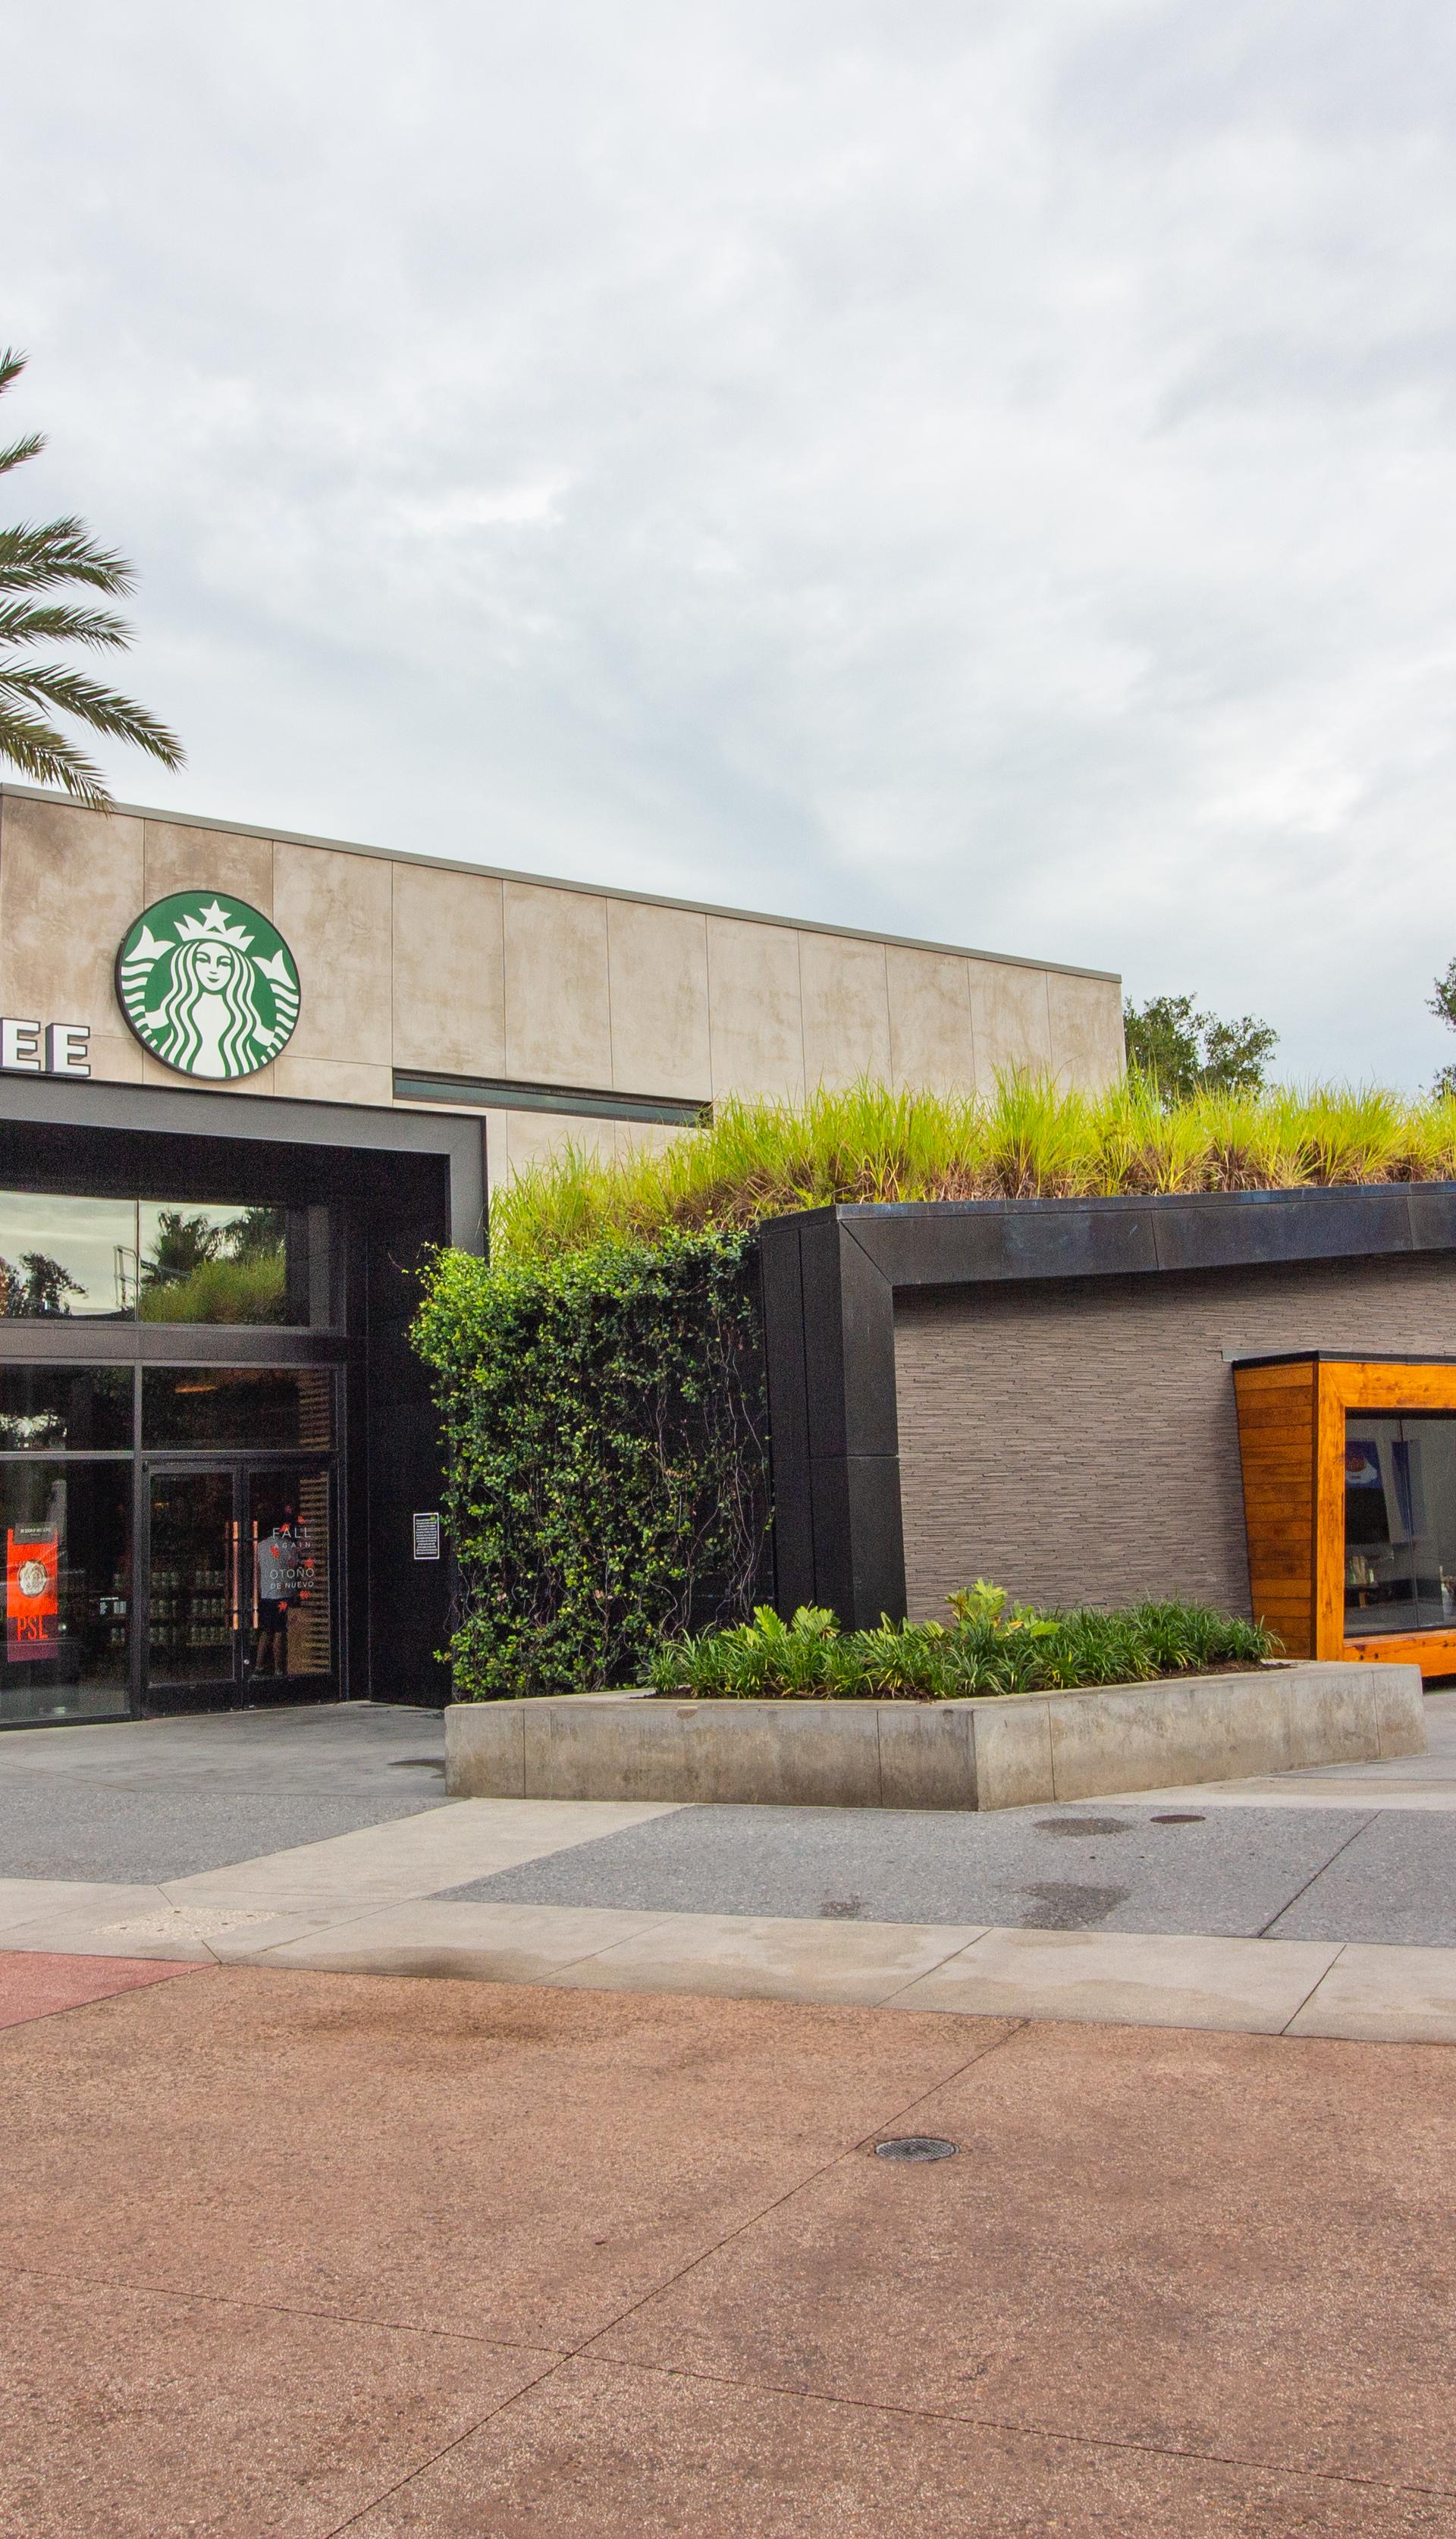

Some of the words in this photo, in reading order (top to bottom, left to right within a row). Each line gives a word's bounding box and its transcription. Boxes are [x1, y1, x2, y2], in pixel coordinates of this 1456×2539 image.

[273, 1527, 312, 1539] FALL
[270, 1567, 315, 1579] OTOÑO
[284, 1580, 314, 1589] NUEVO
[17, 1614, 49, 1642] PSL
